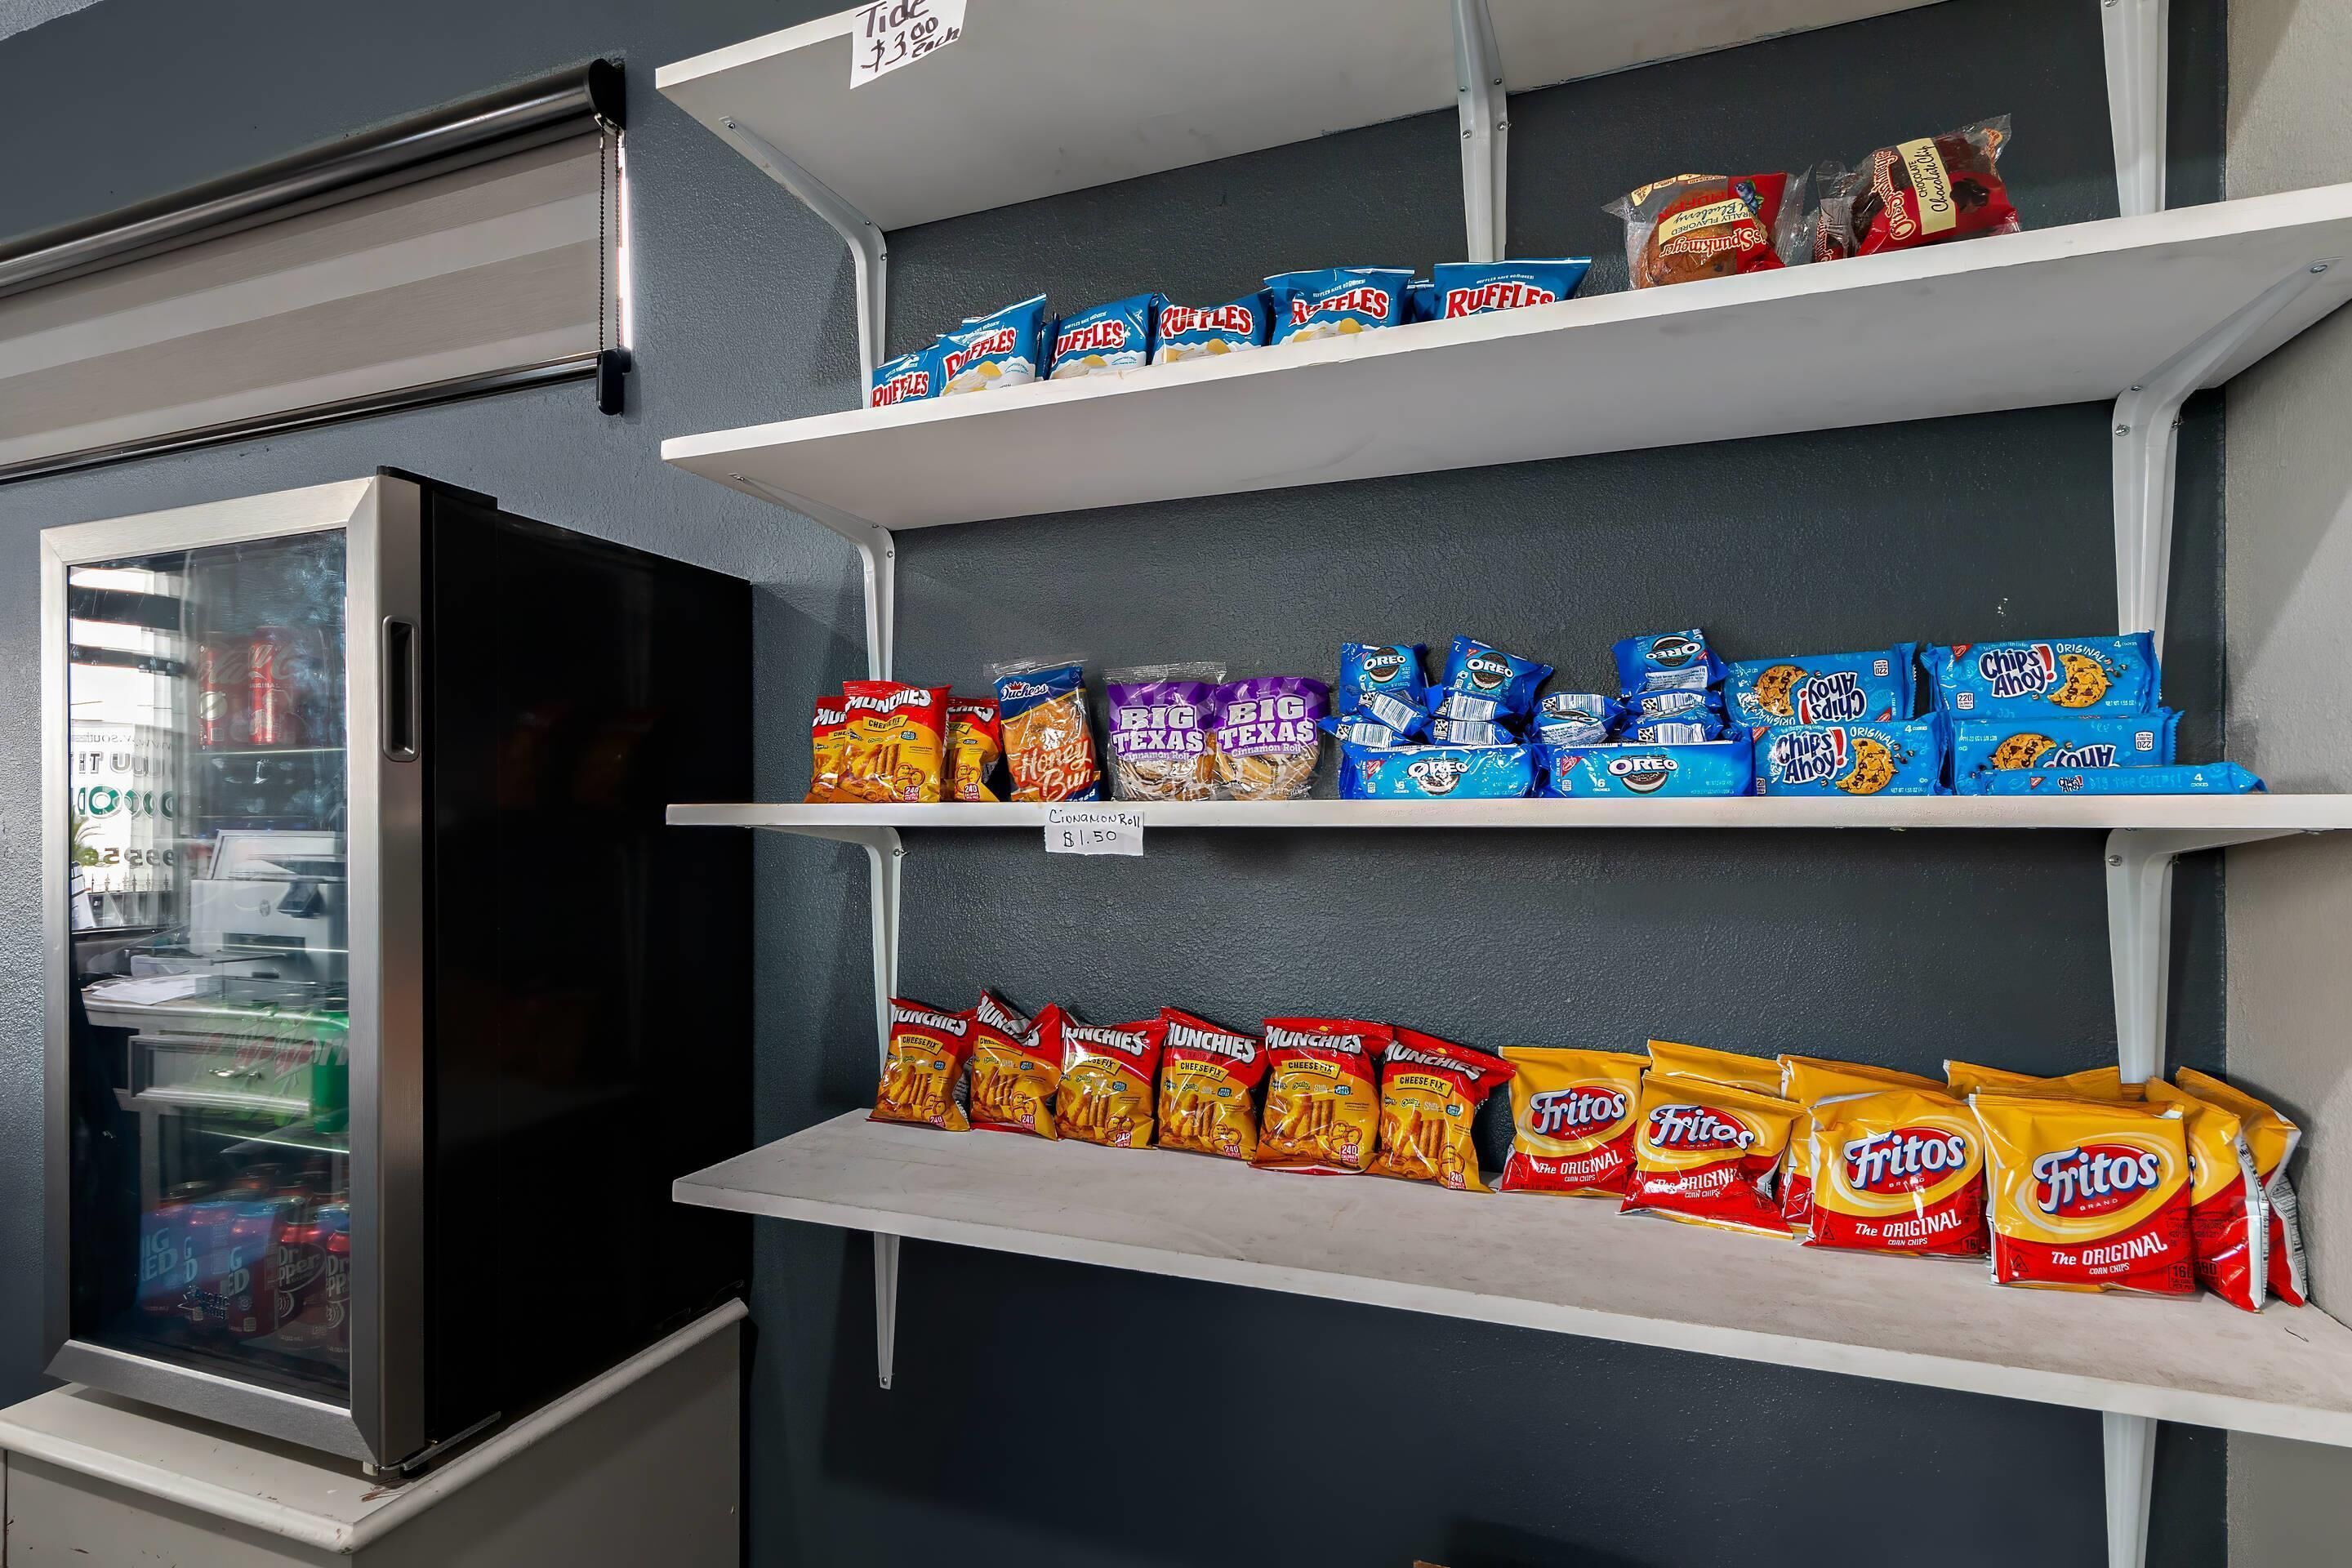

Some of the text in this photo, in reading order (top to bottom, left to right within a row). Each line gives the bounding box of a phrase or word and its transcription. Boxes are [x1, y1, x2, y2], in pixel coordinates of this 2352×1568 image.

[856, 0, 929, 38] Tide
[1909, 161, 1928, 198] CHOCOLATE
[1922, 163, 1949, 212] Chocolate
[1673, 202, 1736, 224] Blueberry
[1671, 216, 1720, 236] FLAVORED
[1659, 228, 1757, 256] Spunkmeyer
[1052, 321, 1125, 364] UFFLES
[1646, 643, 1701, 659] OREO
[2056, 644, 2104, 663] ORIGINAL
[1363, 656, 1405, 670] OREO
[1467, 658, 1513, 678] OREO
[1981, 650, 2039, 679] Chips
[845, 689, 932, 713] MUNCHIES
[1001, 683, 1048, 701] Duchess
[1227, 697, 1304, 725] BIG
[1811, 690, 1865, 720] Chips
[1120, 707, 1195, 729] BIG
[1114, 730, 1203, 752] TEXAS
[1218, 720, 1314, 749] TEXAS
[1850, 727, 1895, 749] ORIGINAL
[1124, 751, 1190, 761] Cinnamon Roll
[1232, 743, 1301, 756] Cinnamon Roll
[1776, 732, 1833, 764] Chips
[1017, 741, 1091, 782] Honey
[1409, 762, 1468, 777] OREO
[1609, 759, 1677, 775] OREO
[964, 785, 978, 793] 240
[1038, 768, 1091, 802] Bun
[2058, 777, 2078, 786] Chips
[1118, 813, 1139, 828] Roll
[1063, 830, 1116, 847] $1.50
[902, 1036, 927, 1046] CHEESE
[1267, 1026, 1361, 1054] MUNCHIES
[1102, 1059, 1114, 1068] FIX
[1181, 1062, 1222, 1075] CHEESE FIX
[1289, 1062, 1333, 1073] CHEESE FIX
[1400, 1076, 1444, 1089] CHEESE FIX
[1022, 1115, 1034, 1124] 240
[1530, 1088, 1626, 1135] Fritos
[1649, 1104, 1755, 1150] Fritos
[1225, 1145, 1239, 1154] 240
[1342, 1145, 1356, 1155] 240
[1843, 1130, 1966, 1189] Fritos
[1538, 1150, 1623, 1175] The ORIGINAL
[1450, 1172, 1463, 1183] 240
[1579, 1174, 1596, 1183] CHIPS
[2032, 1147, 2160, 1214] Fritos
[1702, 1189, 1721, 1197] CHIPS
[2079, 1198, 2119, 1211] BRAND
[1855, 1209, 1962, 1237] The ORIGINAL
[1907, 1237, 1928, 1245] CHIPS
[2051, 1232, 2168, 1266] The ORIGINAL
[2088, 1263, 2131, 1275] CORN CHIPS
